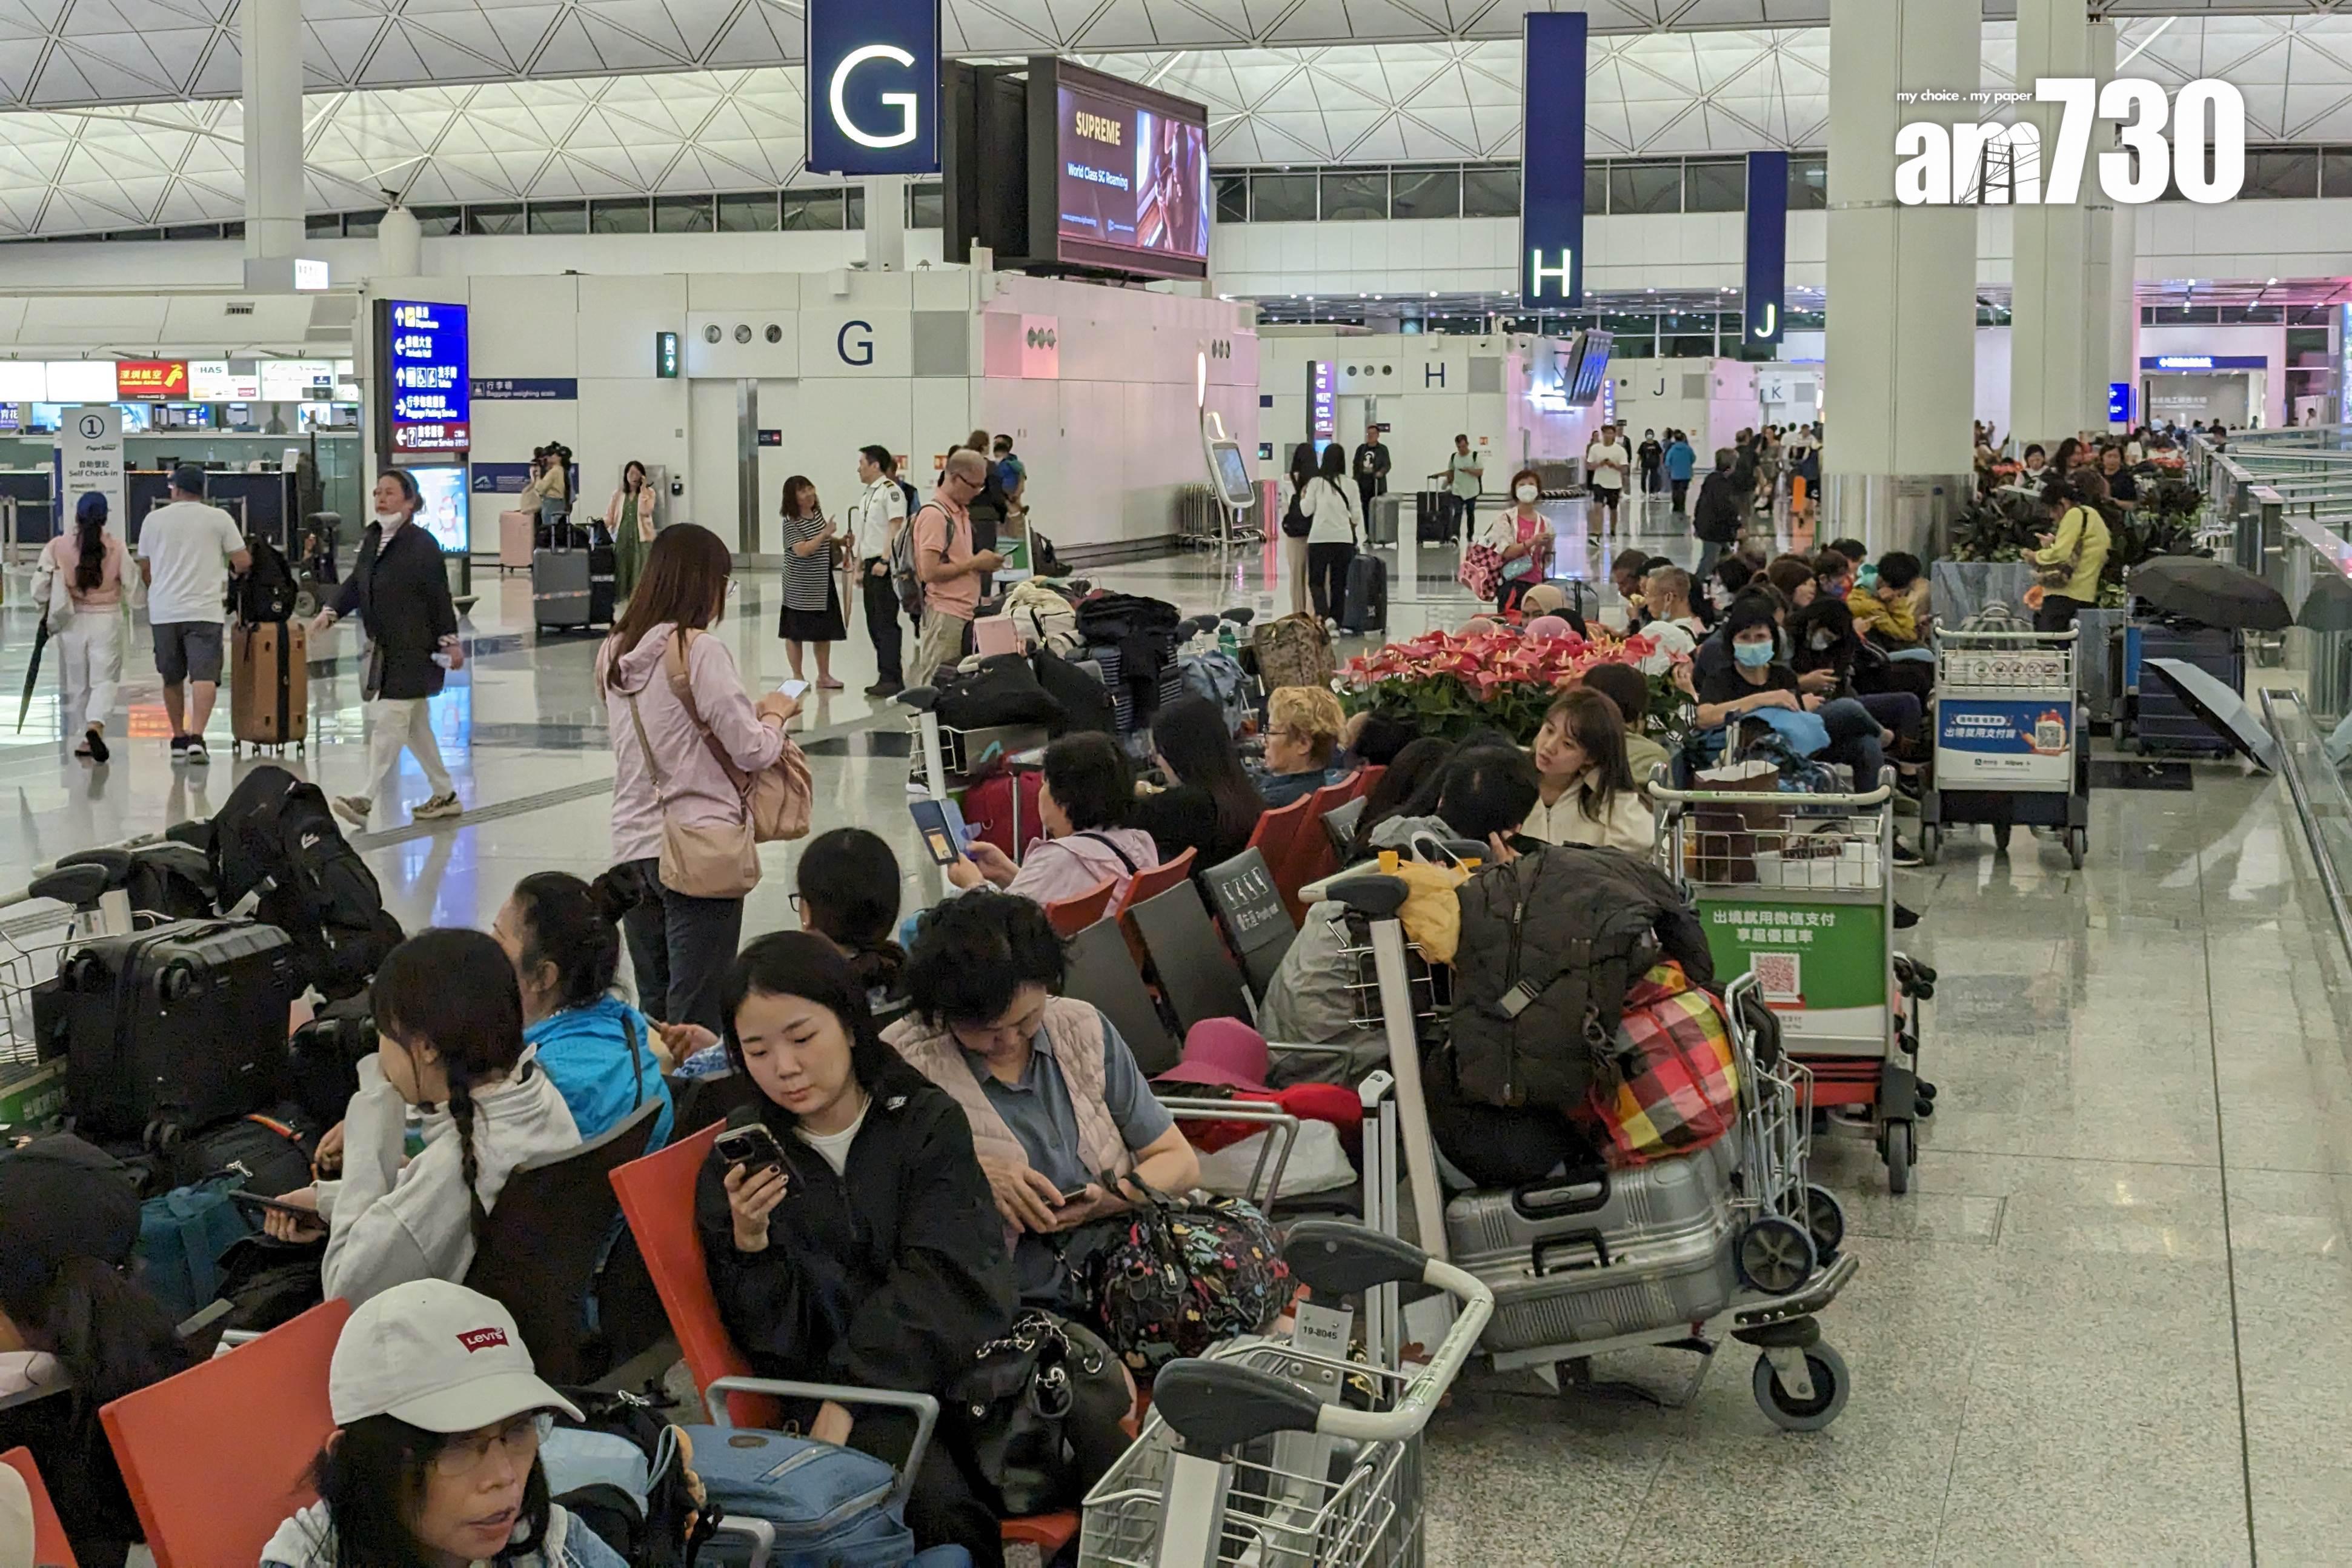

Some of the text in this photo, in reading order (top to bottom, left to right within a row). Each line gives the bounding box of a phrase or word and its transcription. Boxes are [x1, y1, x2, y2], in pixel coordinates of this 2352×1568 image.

[829, 44, 917, 148] G
[1076, 111, 1121, 146] SUPREME
[1068, 162, 1129, 191] World Class 5G Roaming
[1532, 248, 1571, 297] H
[1755, 304, 1775, 338] J
[837, 320, 874, 367] G
[119, 370, 162, 380] 深圳航空
[1425, 362, 1444, 388] H
[1653, 377, 1665, 396] J
[1771, 386, 1782, 399] K
[87, 419, 97, 435] 1
[1713, 909, 1836, 927] 出境就用微信支付
[1303, 1326, 1338, 1340] 19-8045
